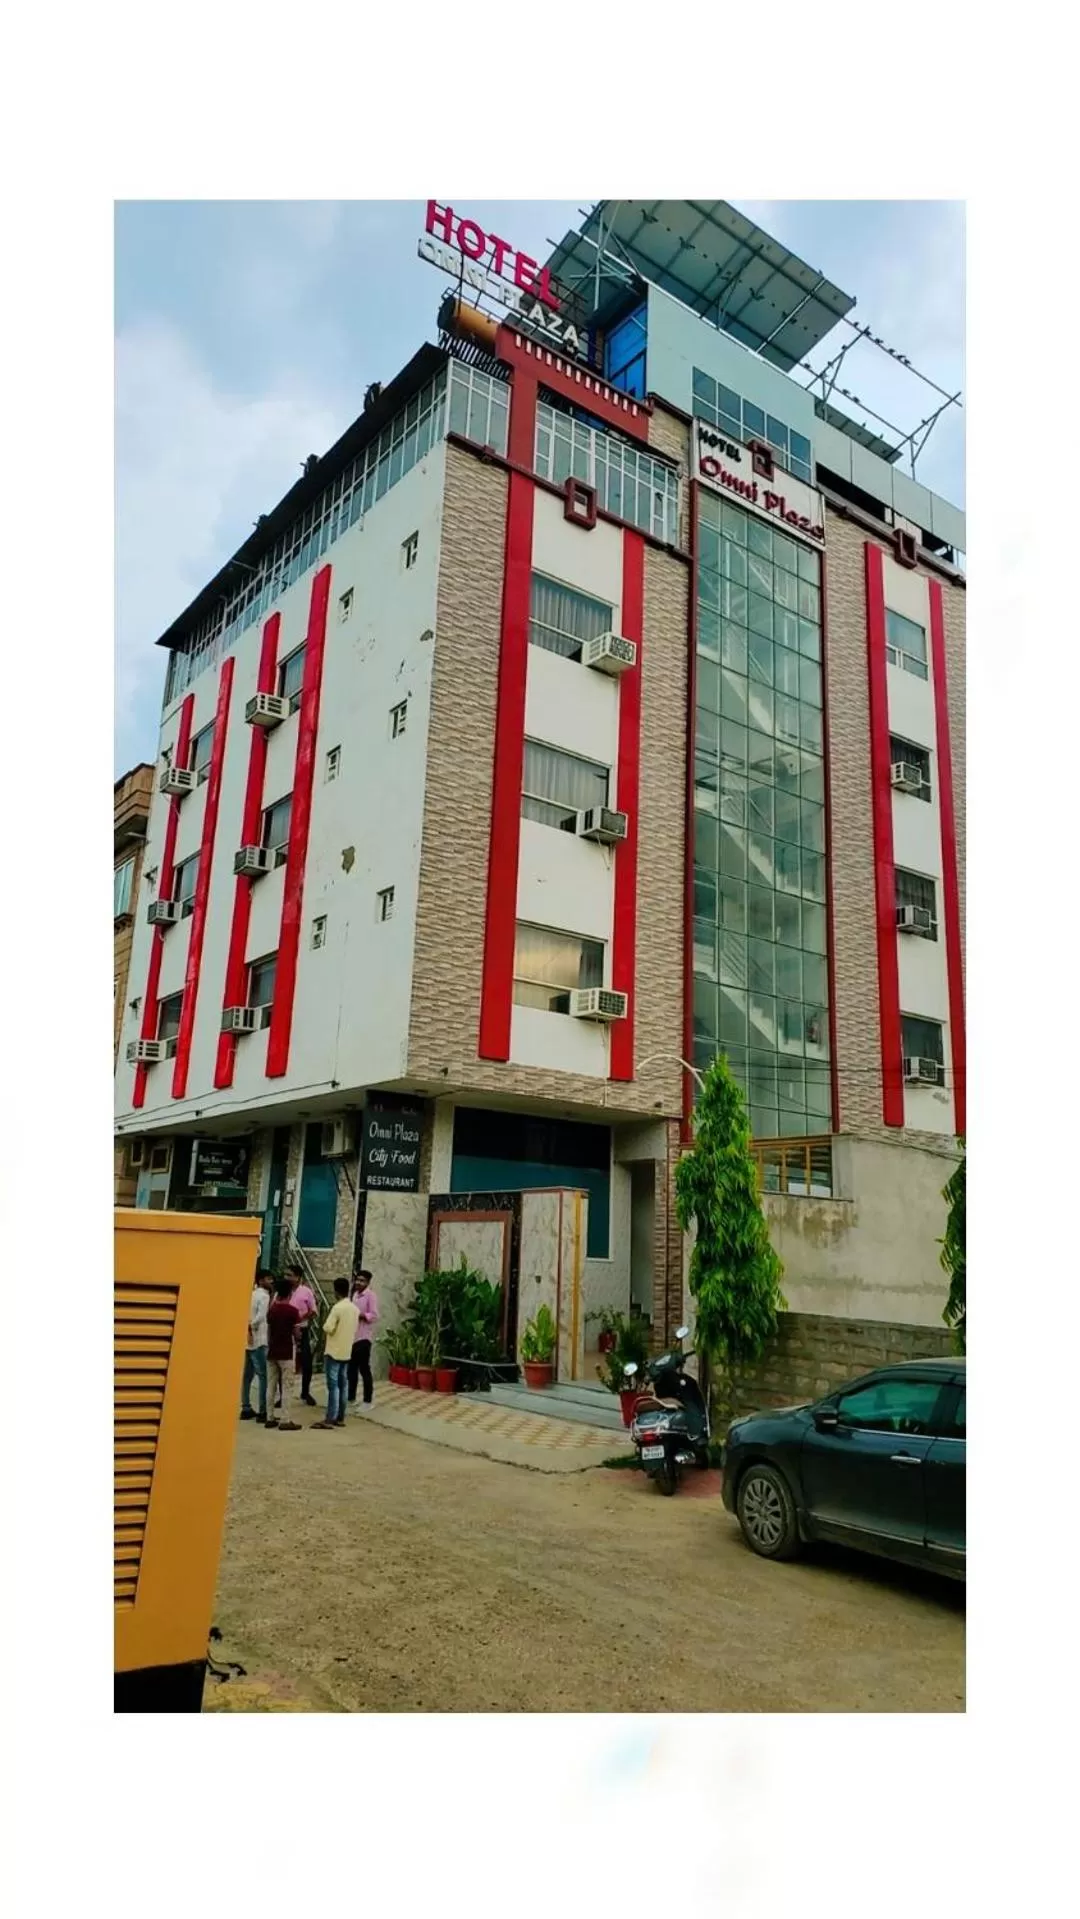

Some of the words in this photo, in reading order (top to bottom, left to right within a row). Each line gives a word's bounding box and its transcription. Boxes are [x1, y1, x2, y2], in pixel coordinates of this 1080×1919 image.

[425, 199, 561, 311] HOTEL
[500, 283, 580, 349] PLAZA
[699, 427, 741, 462] HOTEL
[700, 456, 758, 502] Omni
[763, 489, 824, 540] Plaza
[369, 1121, 392, 1138] Omni
[394, 1120, 419, 1142] Plaza
[369, 1146, 388, 1168] City
[391, 1149, 416, 1165] Food
[366, 1175, 414, 1188] RESTAURANT
